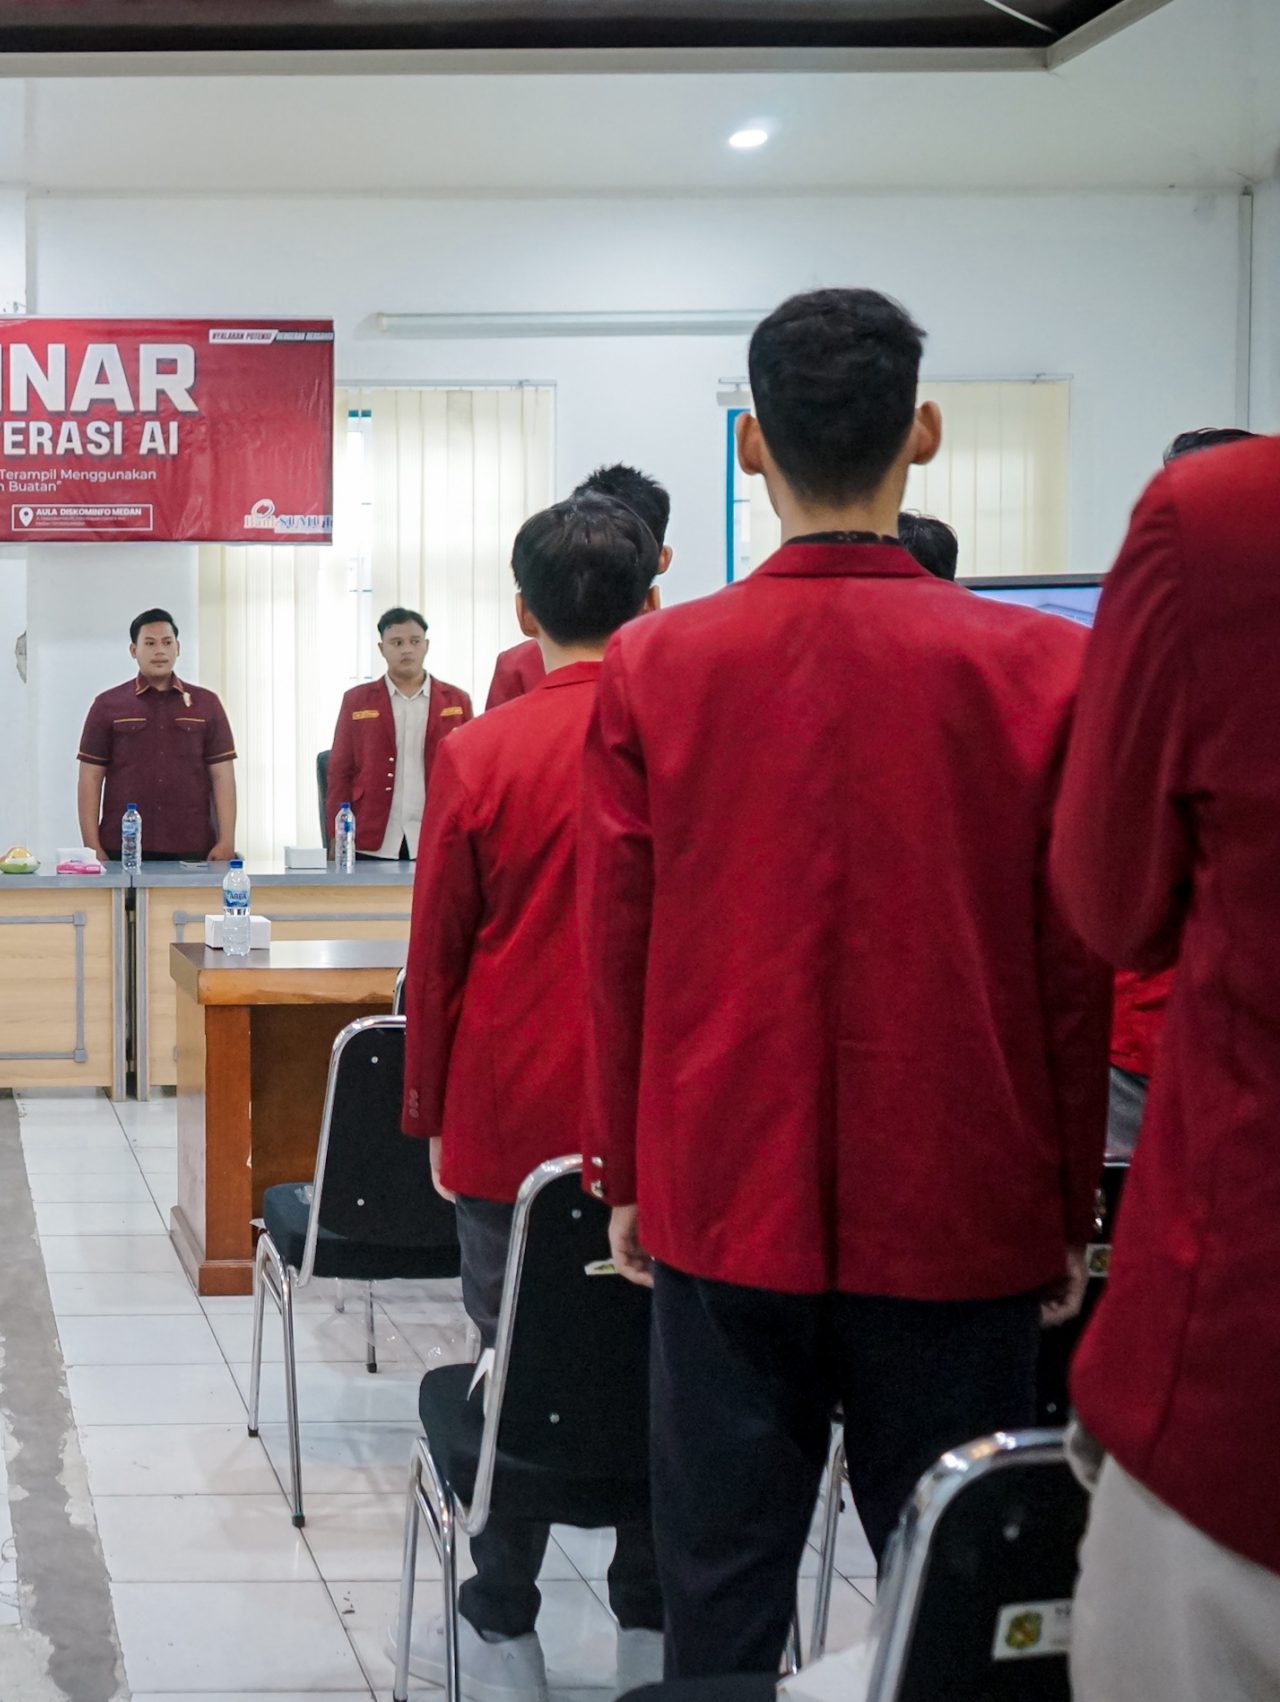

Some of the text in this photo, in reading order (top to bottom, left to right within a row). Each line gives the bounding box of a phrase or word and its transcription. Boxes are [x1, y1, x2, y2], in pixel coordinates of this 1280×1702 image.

[139, 421, 179, 456] AI
[60, 469, 157, 482] Menggunakan
[36, 508, 142, 516] AULA DISKOMINFO MEDAN
